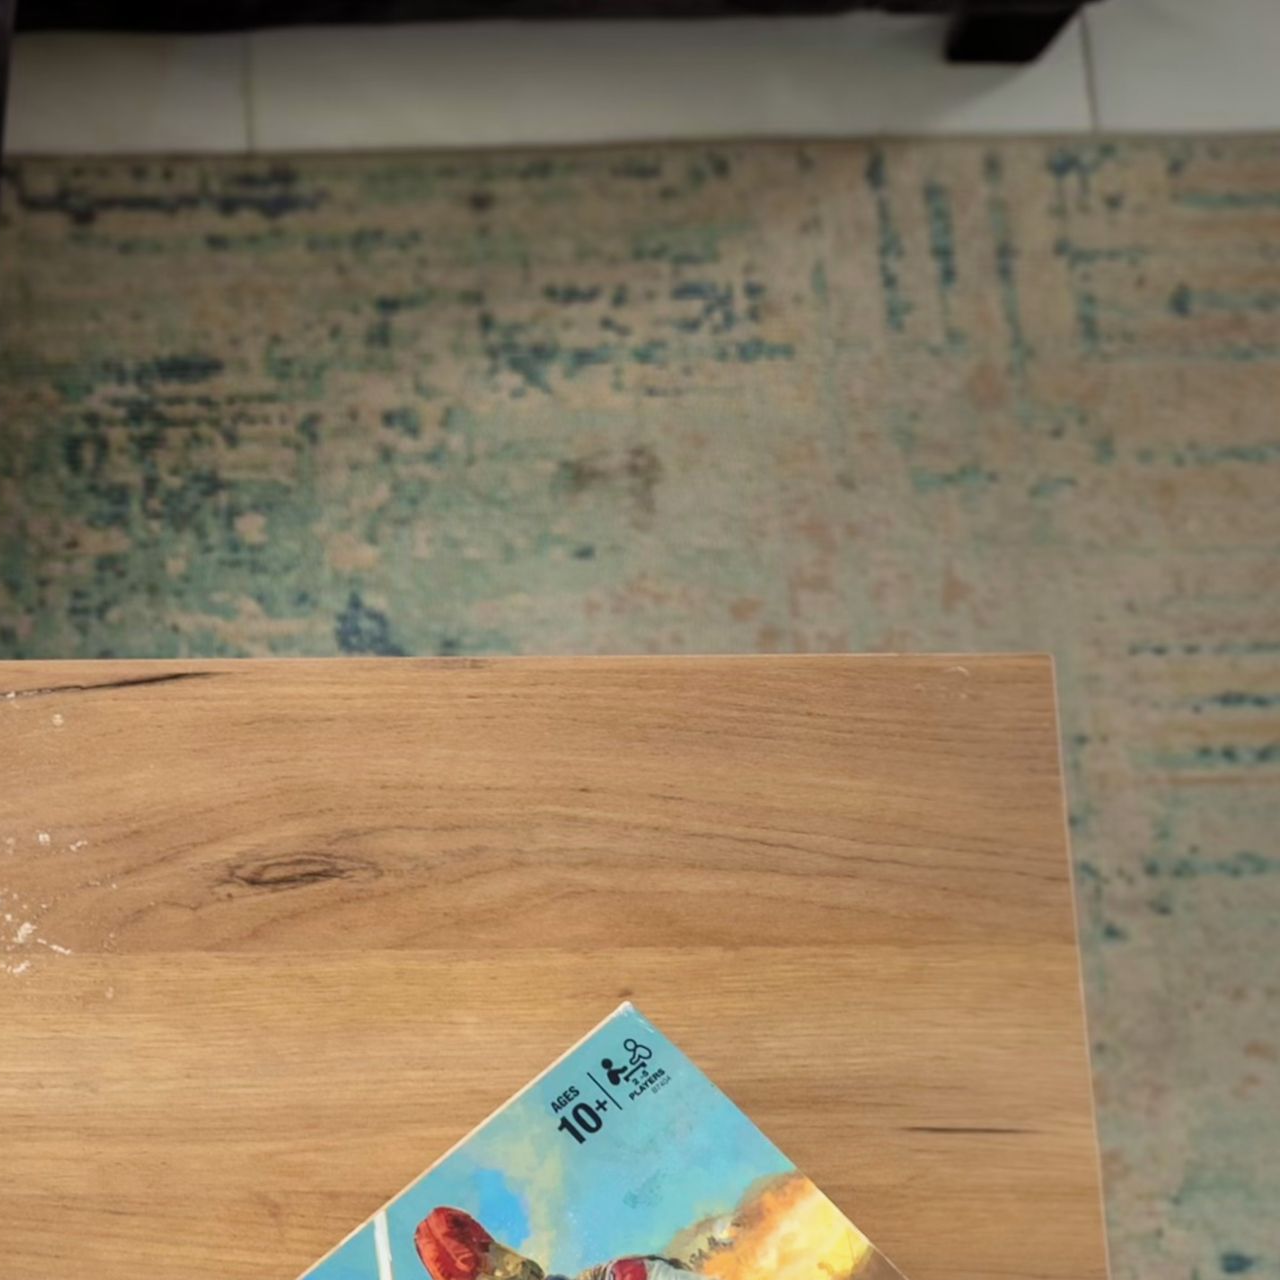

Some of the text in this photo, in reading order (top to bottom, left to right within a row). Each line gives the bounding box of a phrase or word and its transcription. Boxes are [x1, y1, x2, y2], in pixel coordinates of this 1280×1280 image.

[550, 1085, 580, 1113] AGES
[628, 1067, 665, 1101] PLAYERS
[557, 1097, 608, 1144] 10+
